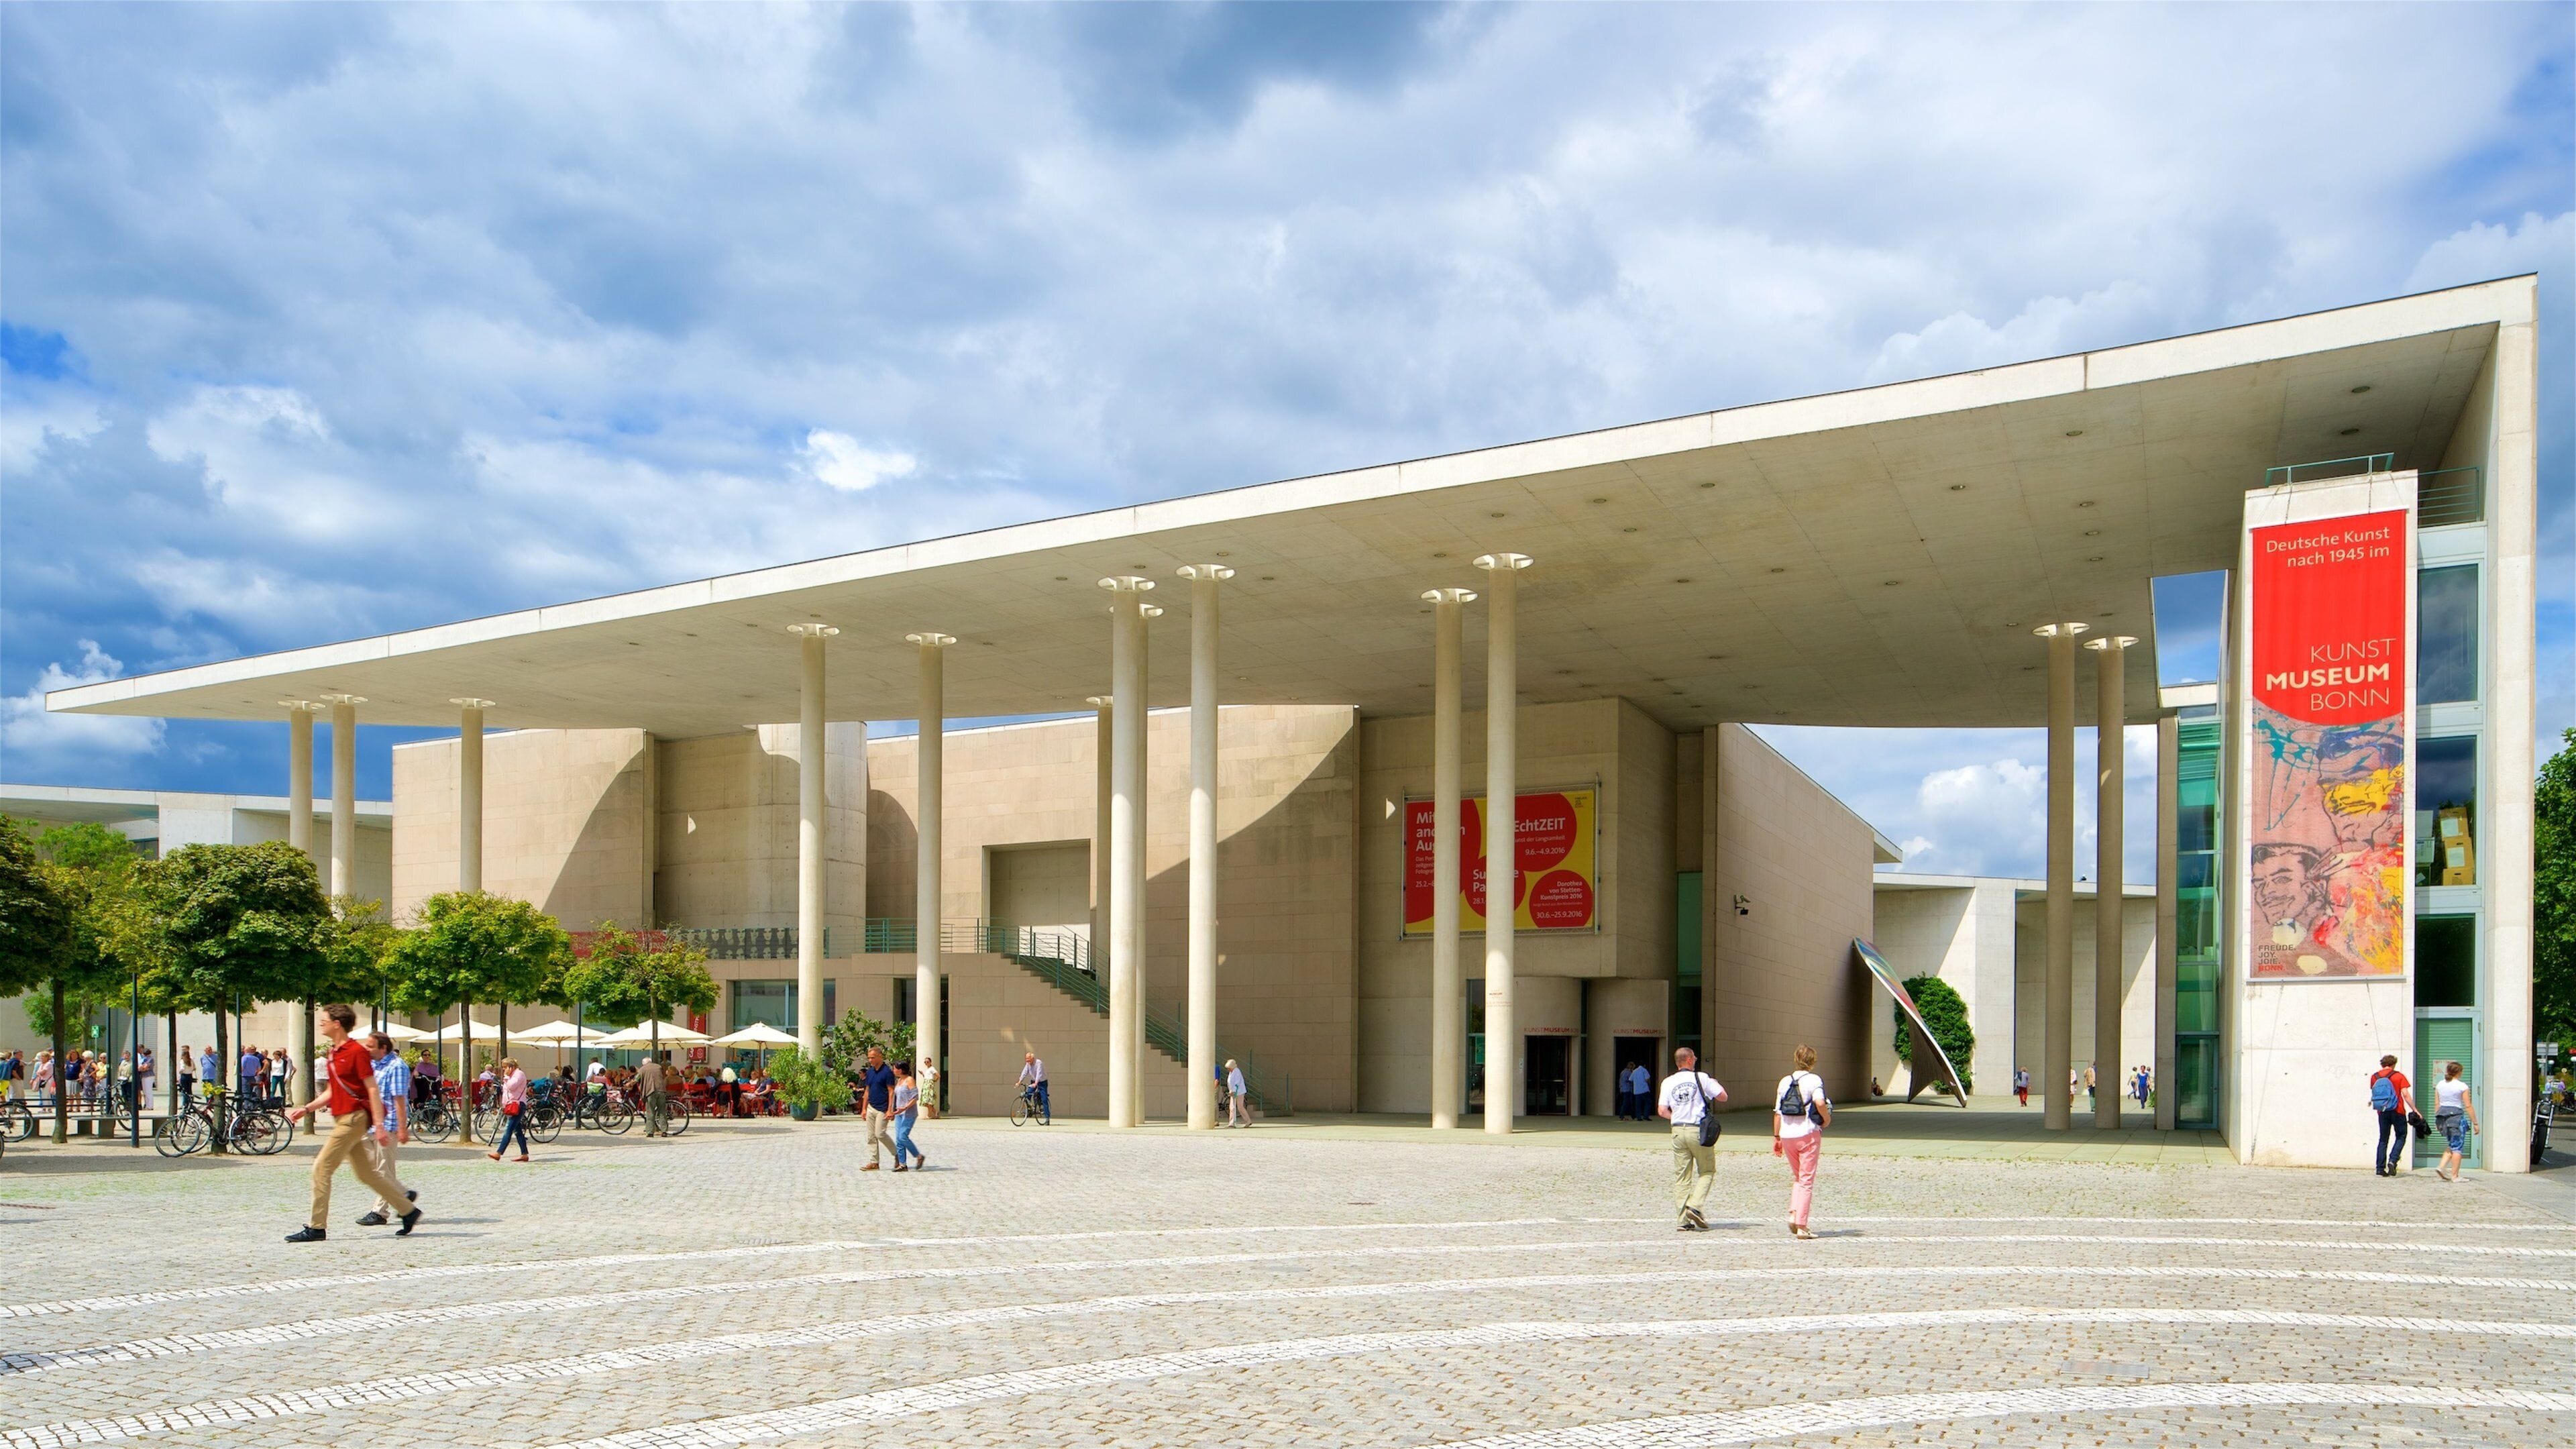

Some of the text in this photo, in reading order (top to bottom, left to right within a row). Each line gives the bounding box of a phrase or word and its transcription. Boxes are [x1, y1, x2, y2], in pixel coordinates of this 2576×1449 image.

[2266, 527, 2390, 553] Deutsche Kunst
[2287, 546, 2390, 568] nach 1945 im
[2310, 638, 2396, 663] KUNST
[2266, 663, 2390, 691] MUSEUM
[2310, 688, 2390, 711] BONN
[1514, 817, 1566, 833] EchtZEIT
[1473, 882, 1486, 892] Pa
